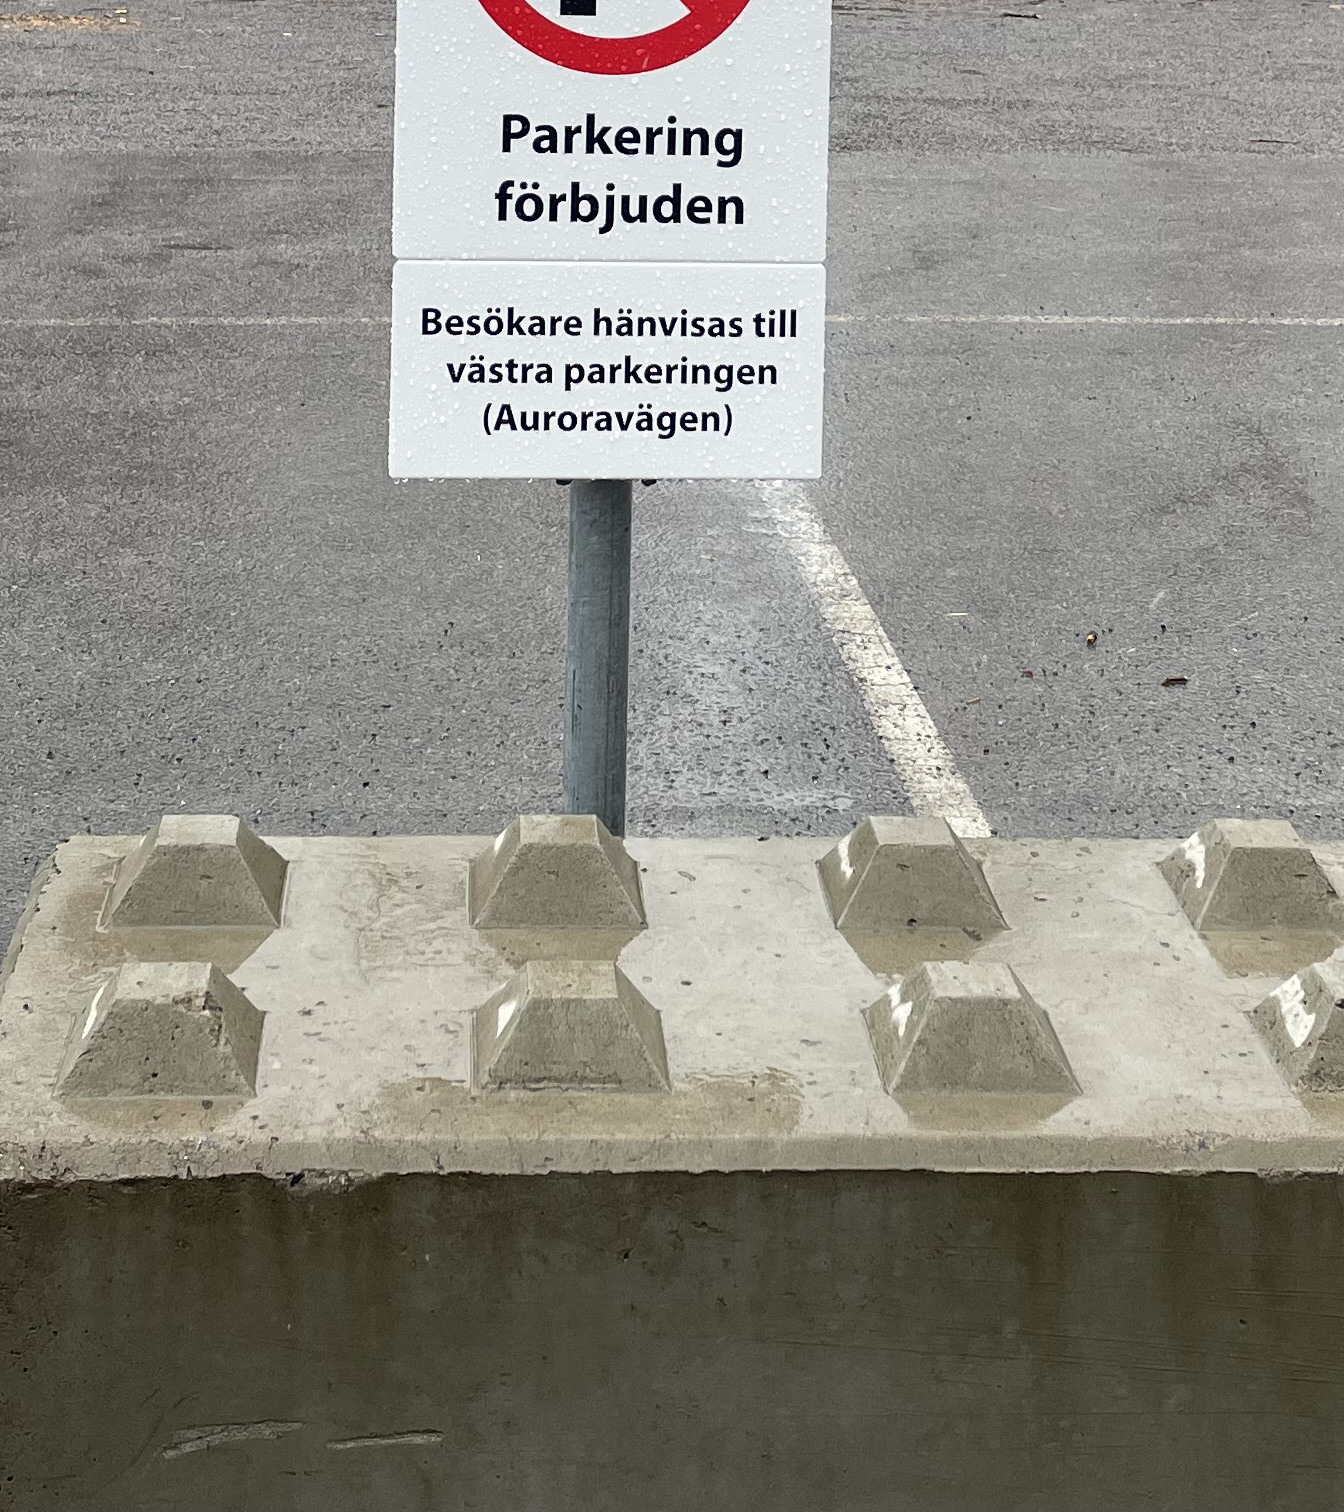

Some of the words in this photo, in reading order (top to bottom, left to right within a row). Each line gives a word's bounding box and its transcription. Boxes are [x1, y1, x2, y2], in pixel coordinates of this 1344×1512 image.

[501, 113, 743, 168] Parkering
[494, 179, 745, 235] förbjuden
[421, 306, 583, 337] Besökare
[593, 307, 743, 338] hänvisas
[752, 308, 798, 339] till
[446, 354, 553, 385] västra
[564, 356, 778, 393] parkeringen
[482, 402, 733, 440] (Auroravägen)
